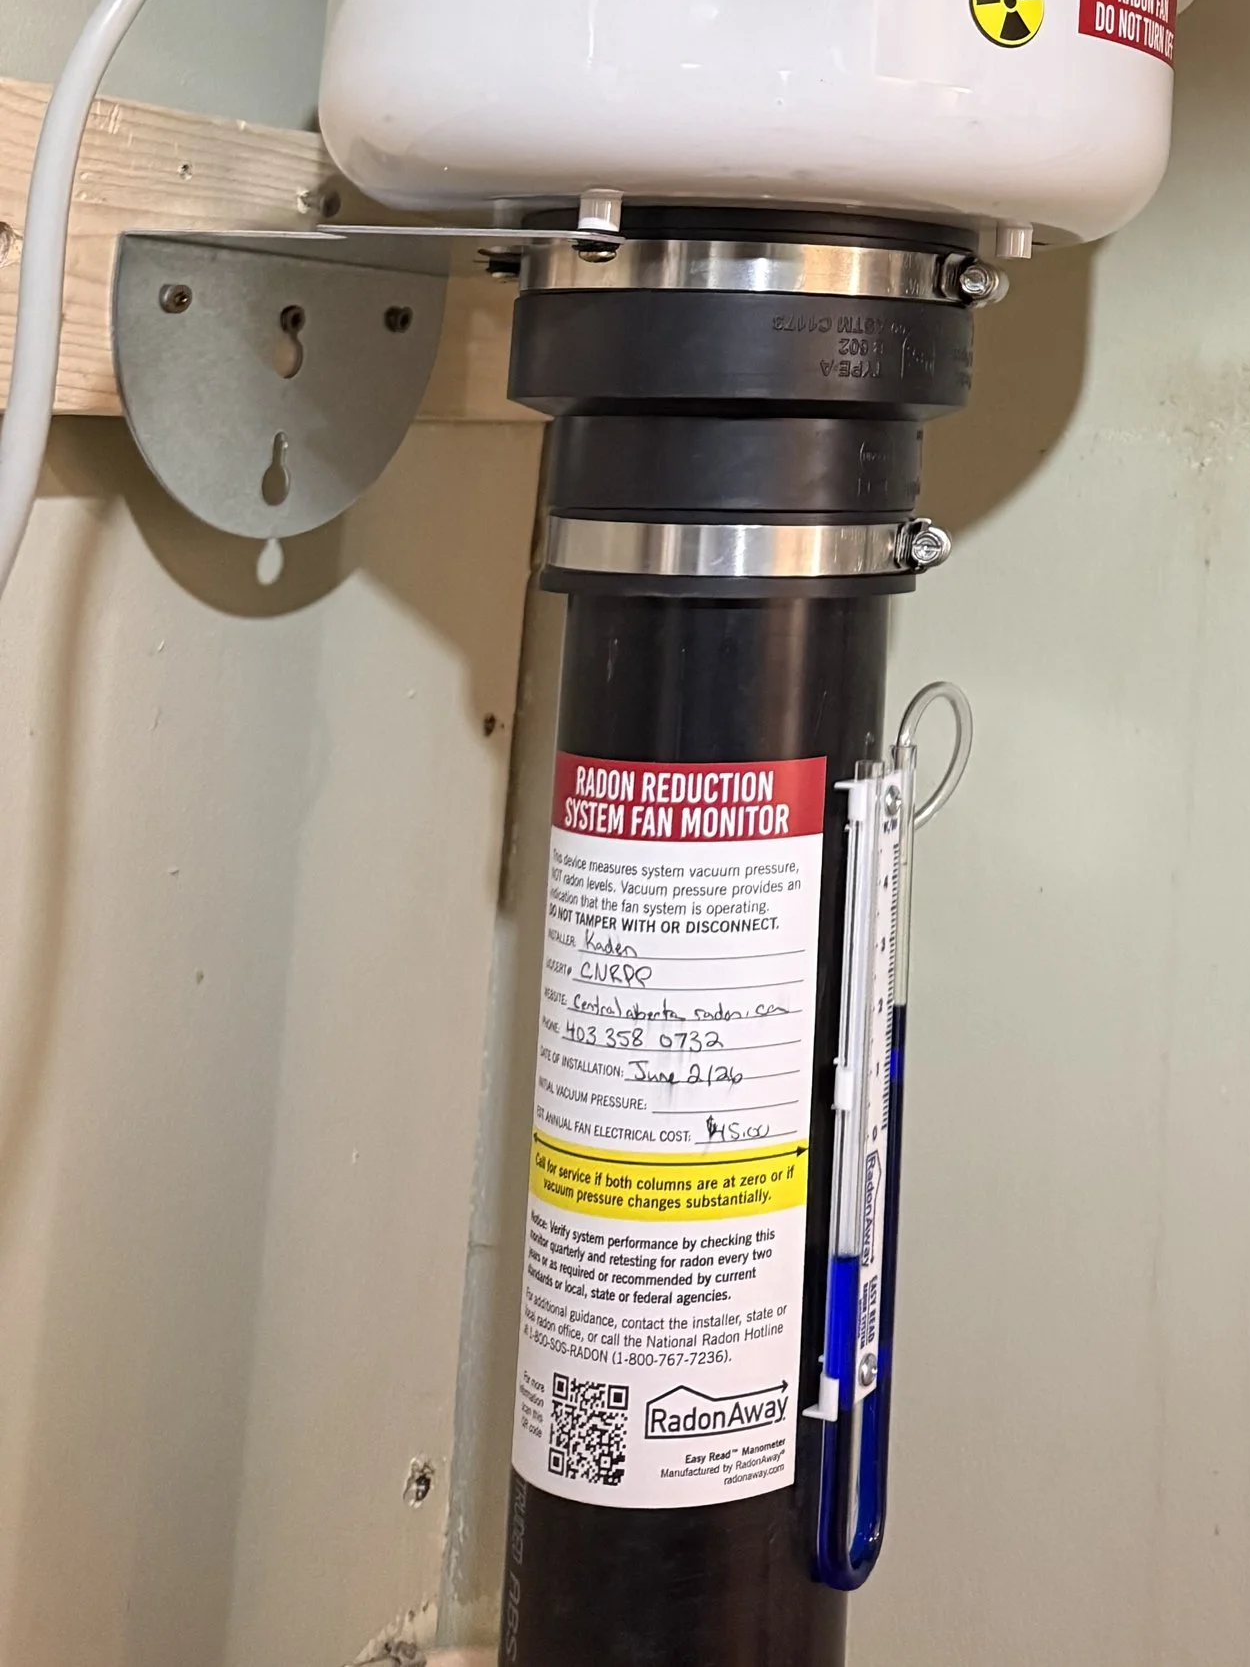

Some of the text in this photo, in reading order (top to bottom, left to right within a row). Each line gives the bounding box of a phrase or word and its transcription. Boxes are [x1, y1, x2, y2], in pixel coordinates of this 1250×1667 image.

[1095, 1, 1114, 35] DO
[1118, 8, 1143, 42] NOT
[1143, 19, 1164, 54] TURN
[576, 765, 774, 804] RADON REDUCTION
[564, 796, 790, 838] SYSTEM FAN MONITOR
[589, 860, 638, 876] measures
[641, 864, 684, 879] system
[689, 866, 740, 878] vacuum
[745, 862, 800, 880] pressure,
[563, 873, 801, 899] radon levels. Vacuum pressure provides an
[558, 907, 780, 934] NOT TAMPER WITH OR DISCONNECT.
[580, 894, 599, 911] that
[602, 897, 618, 912] the
[621, 899, 639, 913] fan
[643, 902, 686, 917] system
[691, 901, 702, 915] is
[706, 900, 770, 917] operating.
[585, 928, 637, 958] Kaden
[566, 1019, 596, 1045] 403
[605, 1027, 643, 1048] 358
[660, 1031, 724, 1052] 0732
[552, 1051, 560, 1064] OF
[562, 1055, 624, 1077] INSTALLATION:
[628, 1060, 680, 1084] June
[556, 1084, 588, 1103] VACUUM
[591, 1093, 647, 1110] PRESSURE:
[546, 1111, 572, 1133] ANNUAL
[575, 1120, 591, 1135] FAN
[594, 1124, 656, 1142] ELECTRICAL
[659, 1130, 691, 1143] COST:
[535, 1152, 795, 1191] Call for service if both columns are at zero or if
[543, 1177, 772, 1212] vacuum pressure changes substantially.
[862, 1154, 877, 1268] RadonAway
[550, 1219, 776, 1252] Verify system performance by checking this
[550, 1240, 773, 1270] quarterly and retesting for radon every two
[549, 1258, 757, 1287] as required or recommended by current
[555, 1279, 563, 1290] or
[565, 1279, 587, 1299] local,
[591, 1287, 616, 1302] state
[618, 1292, 630, 1302] or
[633, 1290, 673, 1304] federal
[676, 1289, 732, 1306] agencies.
[536, 1315, 556, 1332] radon
[558, 1323, 584, 1343] office,
[587, 1332, 599, 1343] or
[601, 1333, 620, 1347] call
[624, 1334, 642, 1348] the
[646, 1334, 697, 1349] National
[702, 1331, 740, 1347] Radon
[744, 1322, 784, 1342] Hotline
[570, 1309, 618, 1329] guidance,
[621, 1317, 664, 1331] contact
[669, 1317, 688, 1330] the
[692, 1313, 742, 1329] installer,
[746, 1307, 774, 1323] state
[776, 1304, 788, 1316] or
[612, 1349, 732, 1367] (1-800-767-7236).
[651, 1396, 789, 1433] RadonAway
[685, 1453, 706, 1465] Easy
[742, 1438, 786, 1457] Manometer
[660, 1464, 720, 1479] Manufactured
[723, 1463, 733, 1474] by
[724, 1464, 785, 1485] radonaway.com
